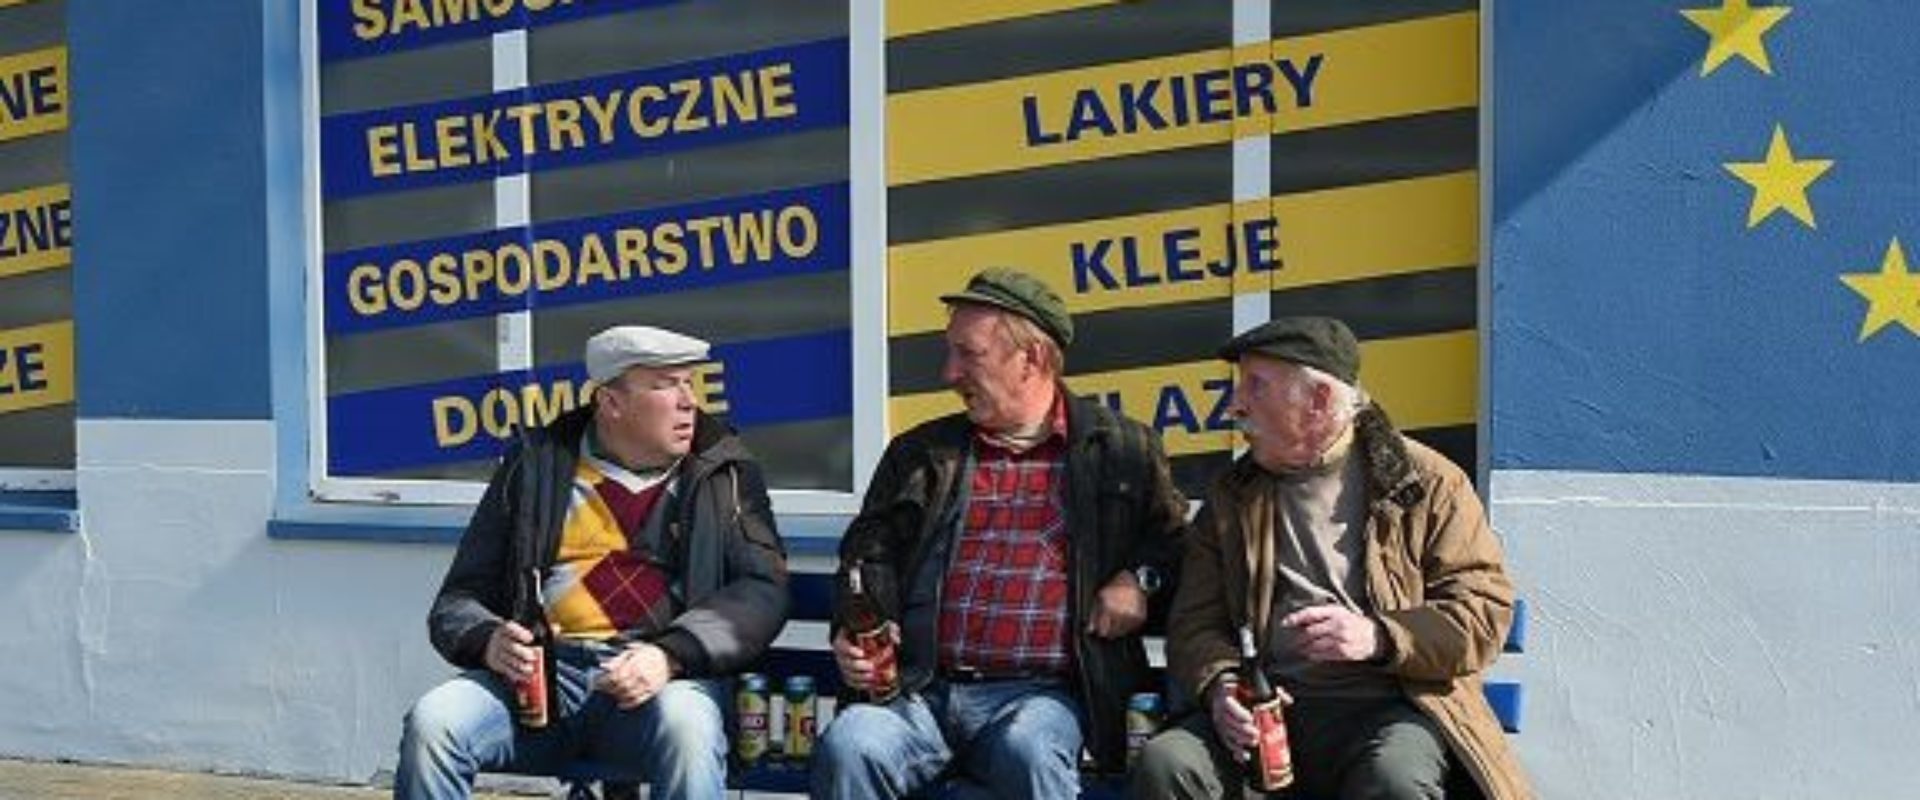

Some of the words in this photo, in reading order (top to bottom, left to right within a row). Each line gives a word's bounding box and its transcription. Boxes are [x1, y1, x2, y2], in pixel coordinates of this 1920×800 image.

[350, 0, 573, 40] SAM
[367, 63, 797, 177] ELEKTRYCZNE
[1022, 54, 1323, 146] LAKIERY
[347, 206, 818, 314] GOSPODARSTWO
[1070, 218, 1283, 293] KLEJE
[432, 361, 729, 447] DOME
